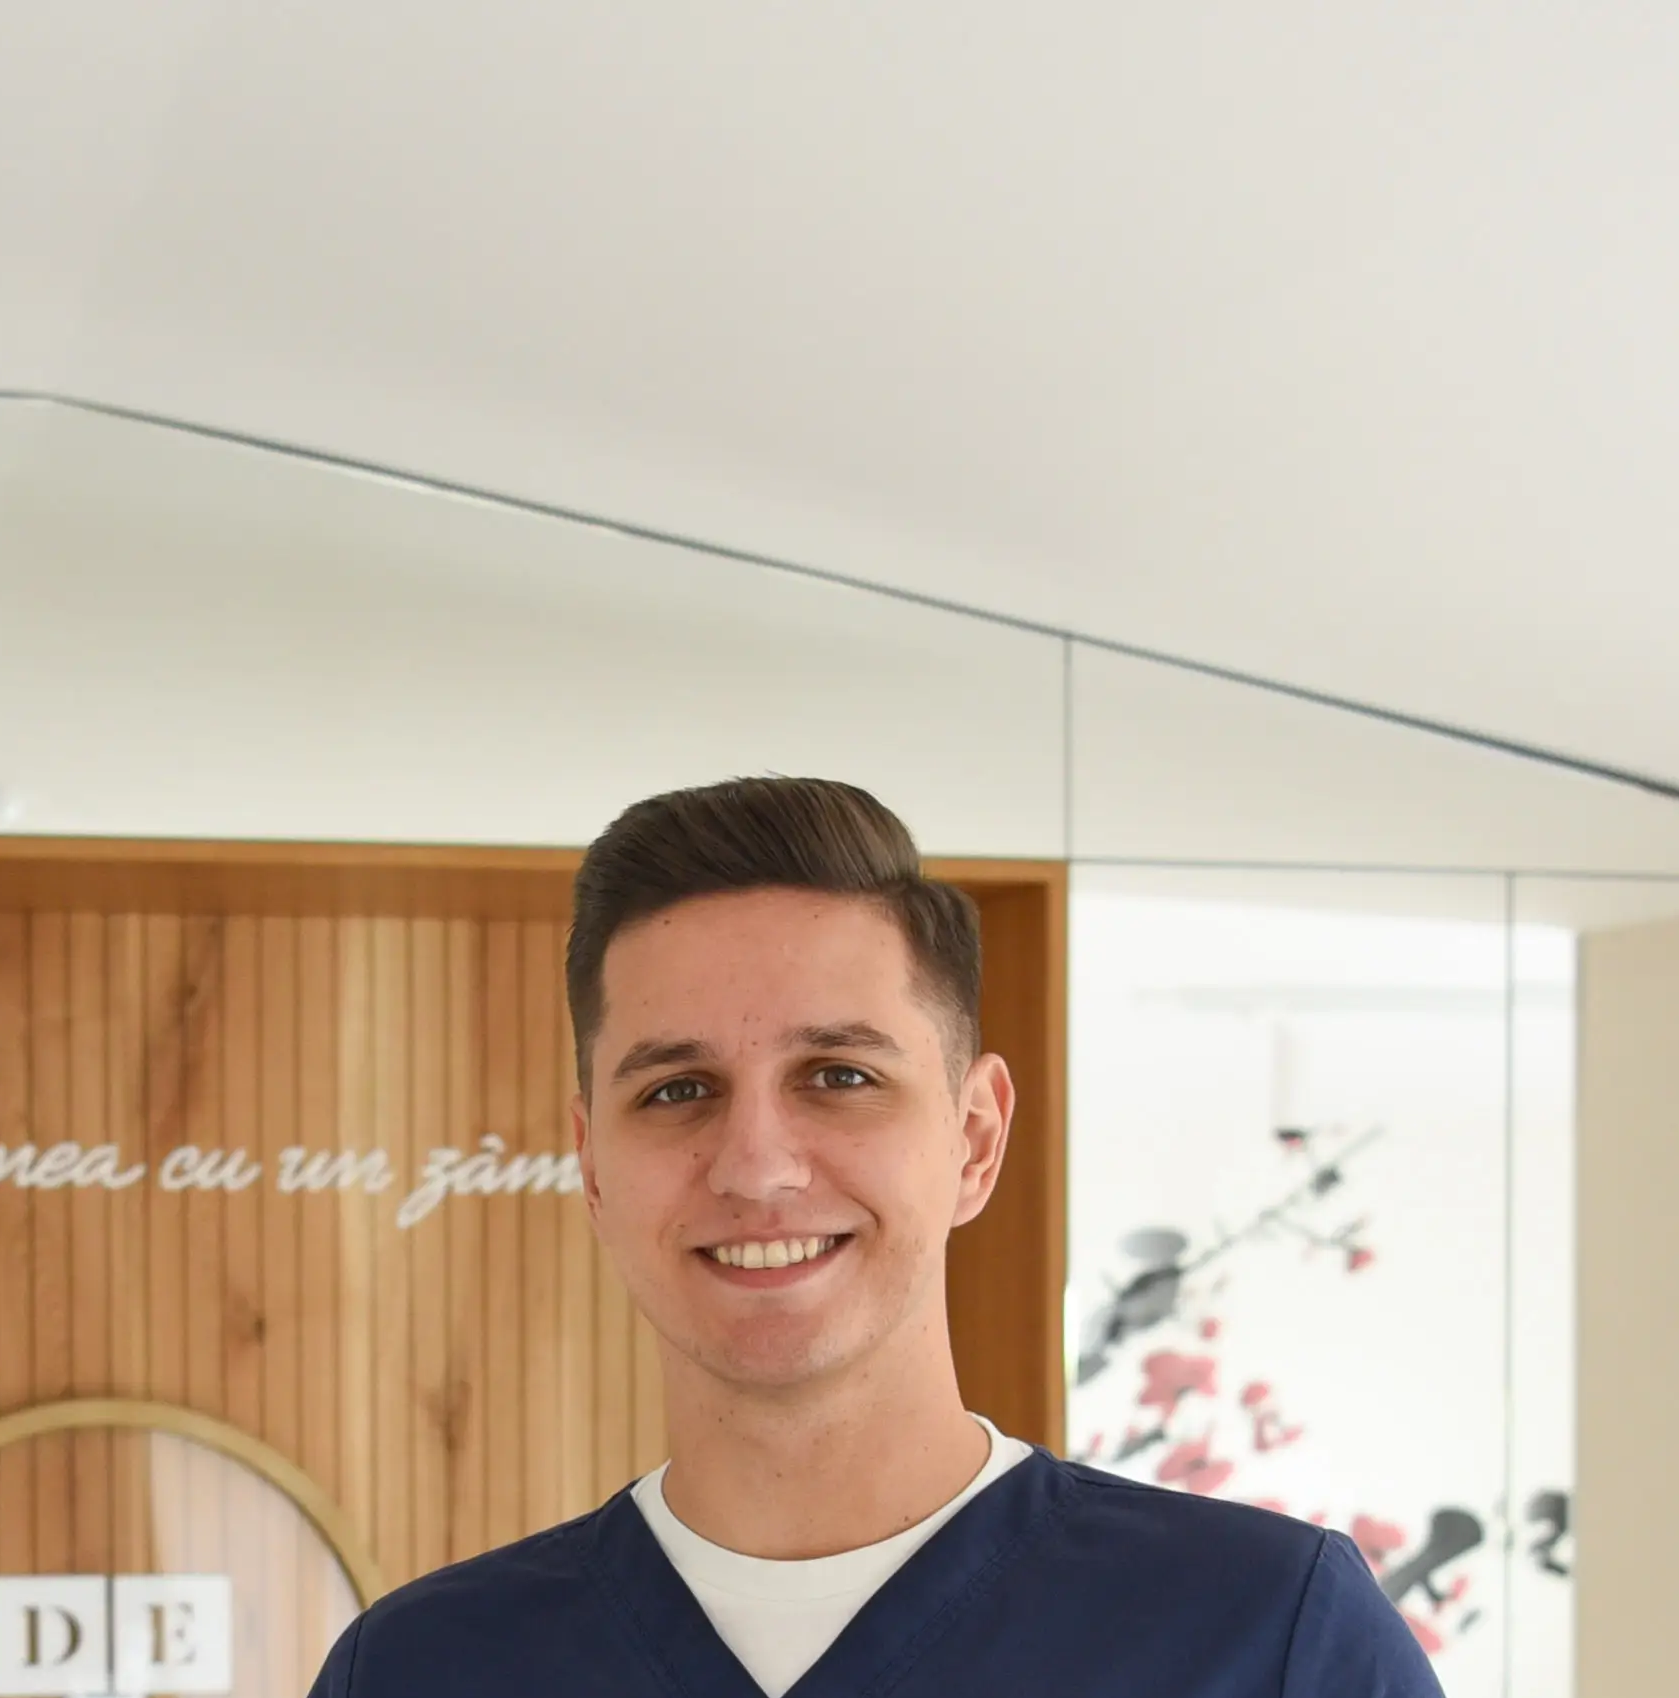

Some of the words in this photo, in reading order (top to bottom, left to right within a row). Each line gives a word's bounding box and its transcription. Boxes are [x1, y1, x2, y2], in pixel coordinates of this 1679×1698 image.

[160, 1145, 262, 1191] cu
[278, 1146, 393, 1193] un
[396, 1132, 584, 1229] zâm
